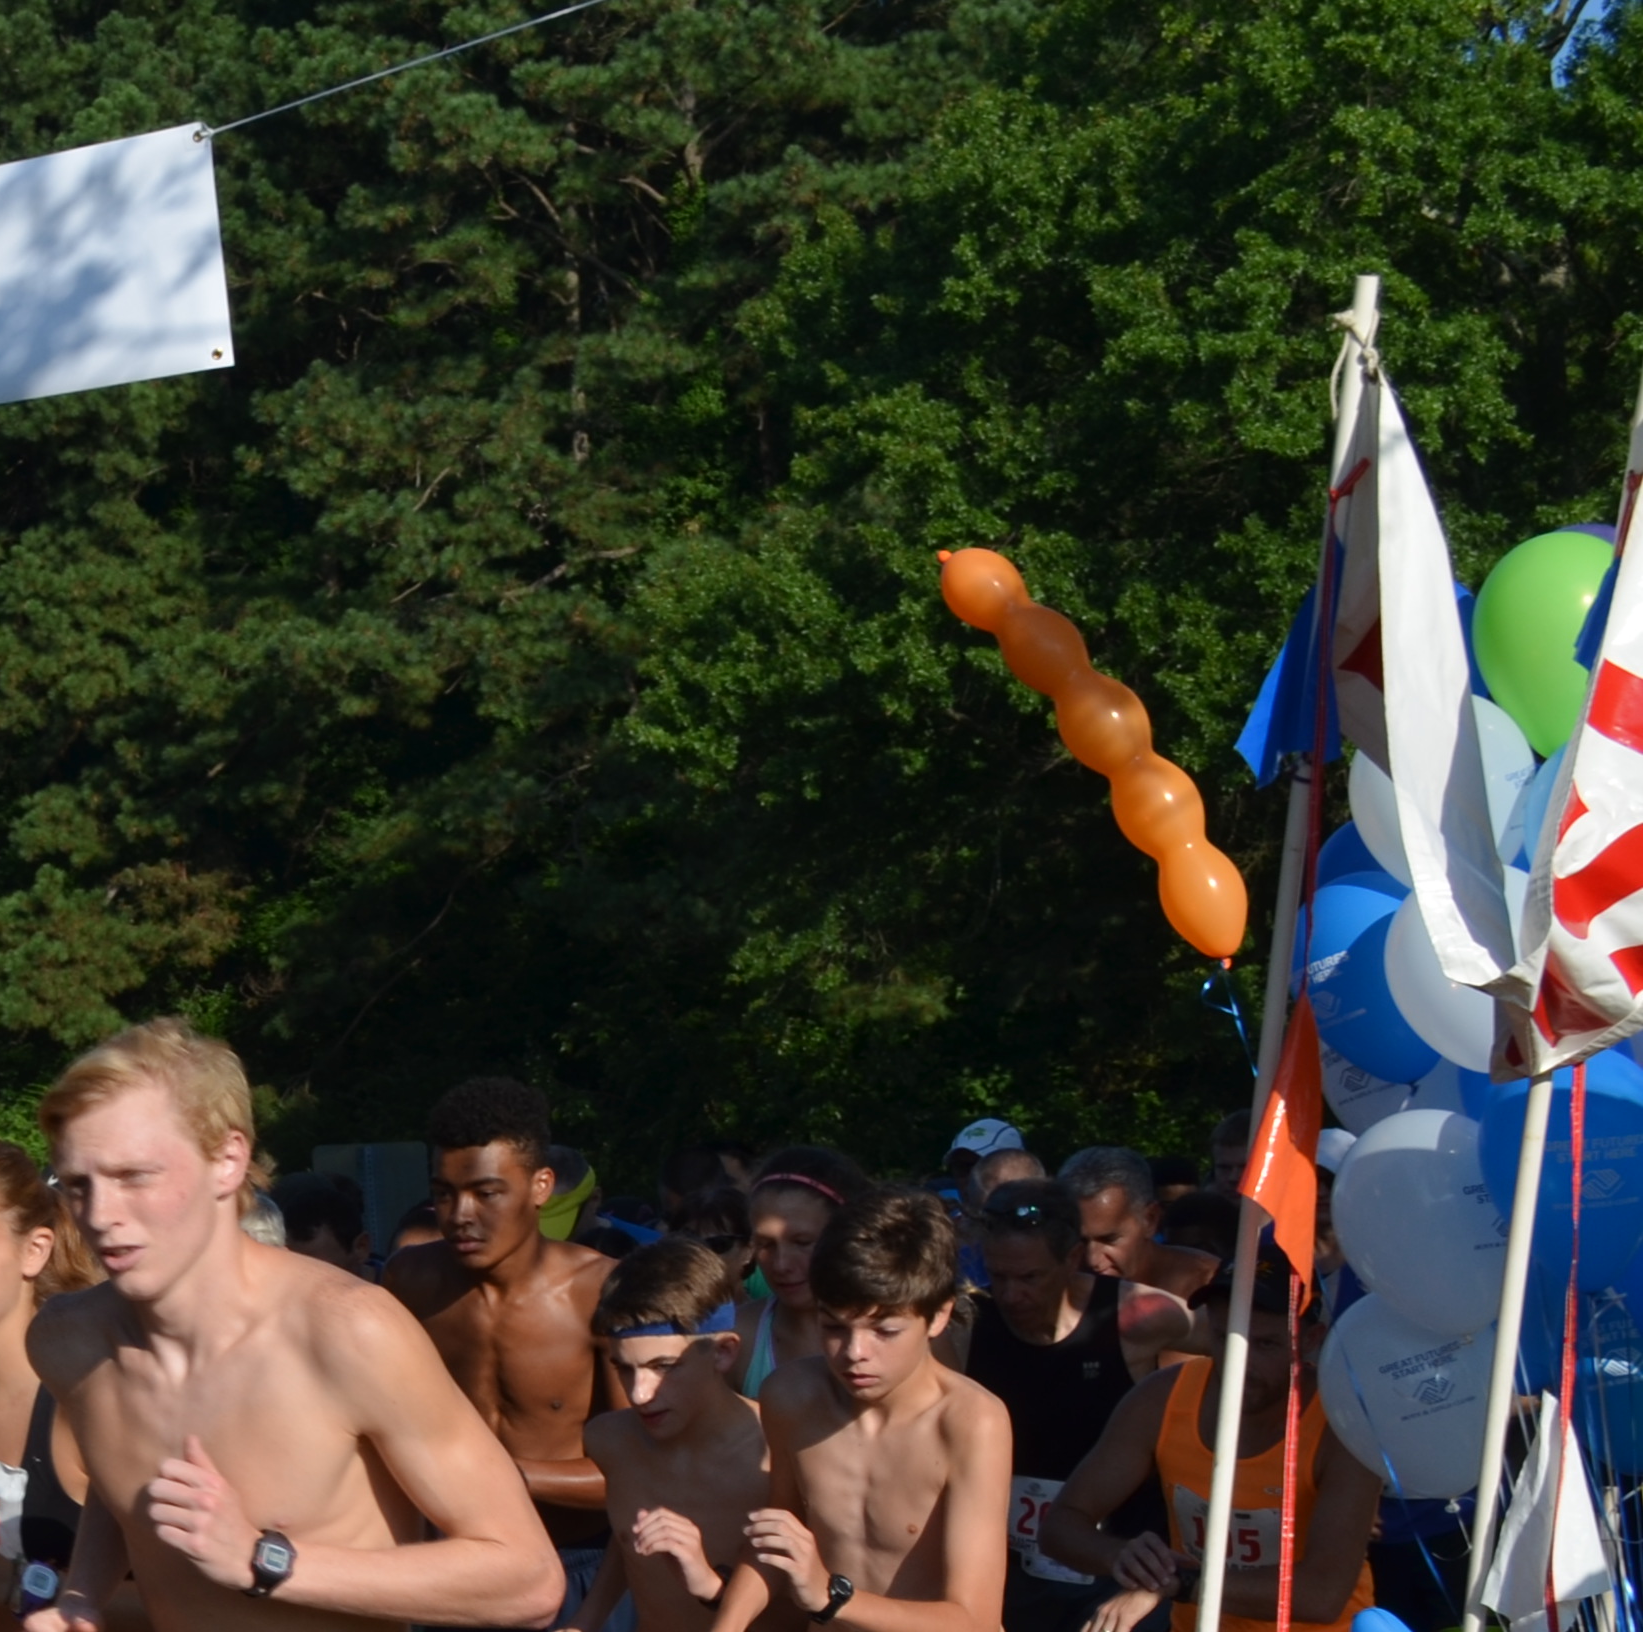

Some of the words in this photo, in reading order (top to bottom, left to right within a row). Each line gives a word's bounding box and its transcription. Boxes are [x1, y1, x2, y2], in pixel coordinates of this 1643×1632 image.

[1307, 950, 1351, 975] UTURES
[1378, 1356, 1414, 1375] GREAT
[1414, 1340, 1461, 1362] FUTURES
[1391, 1362, 1426, 1380] START
[1191, 1516, 1261, 1564] 15
